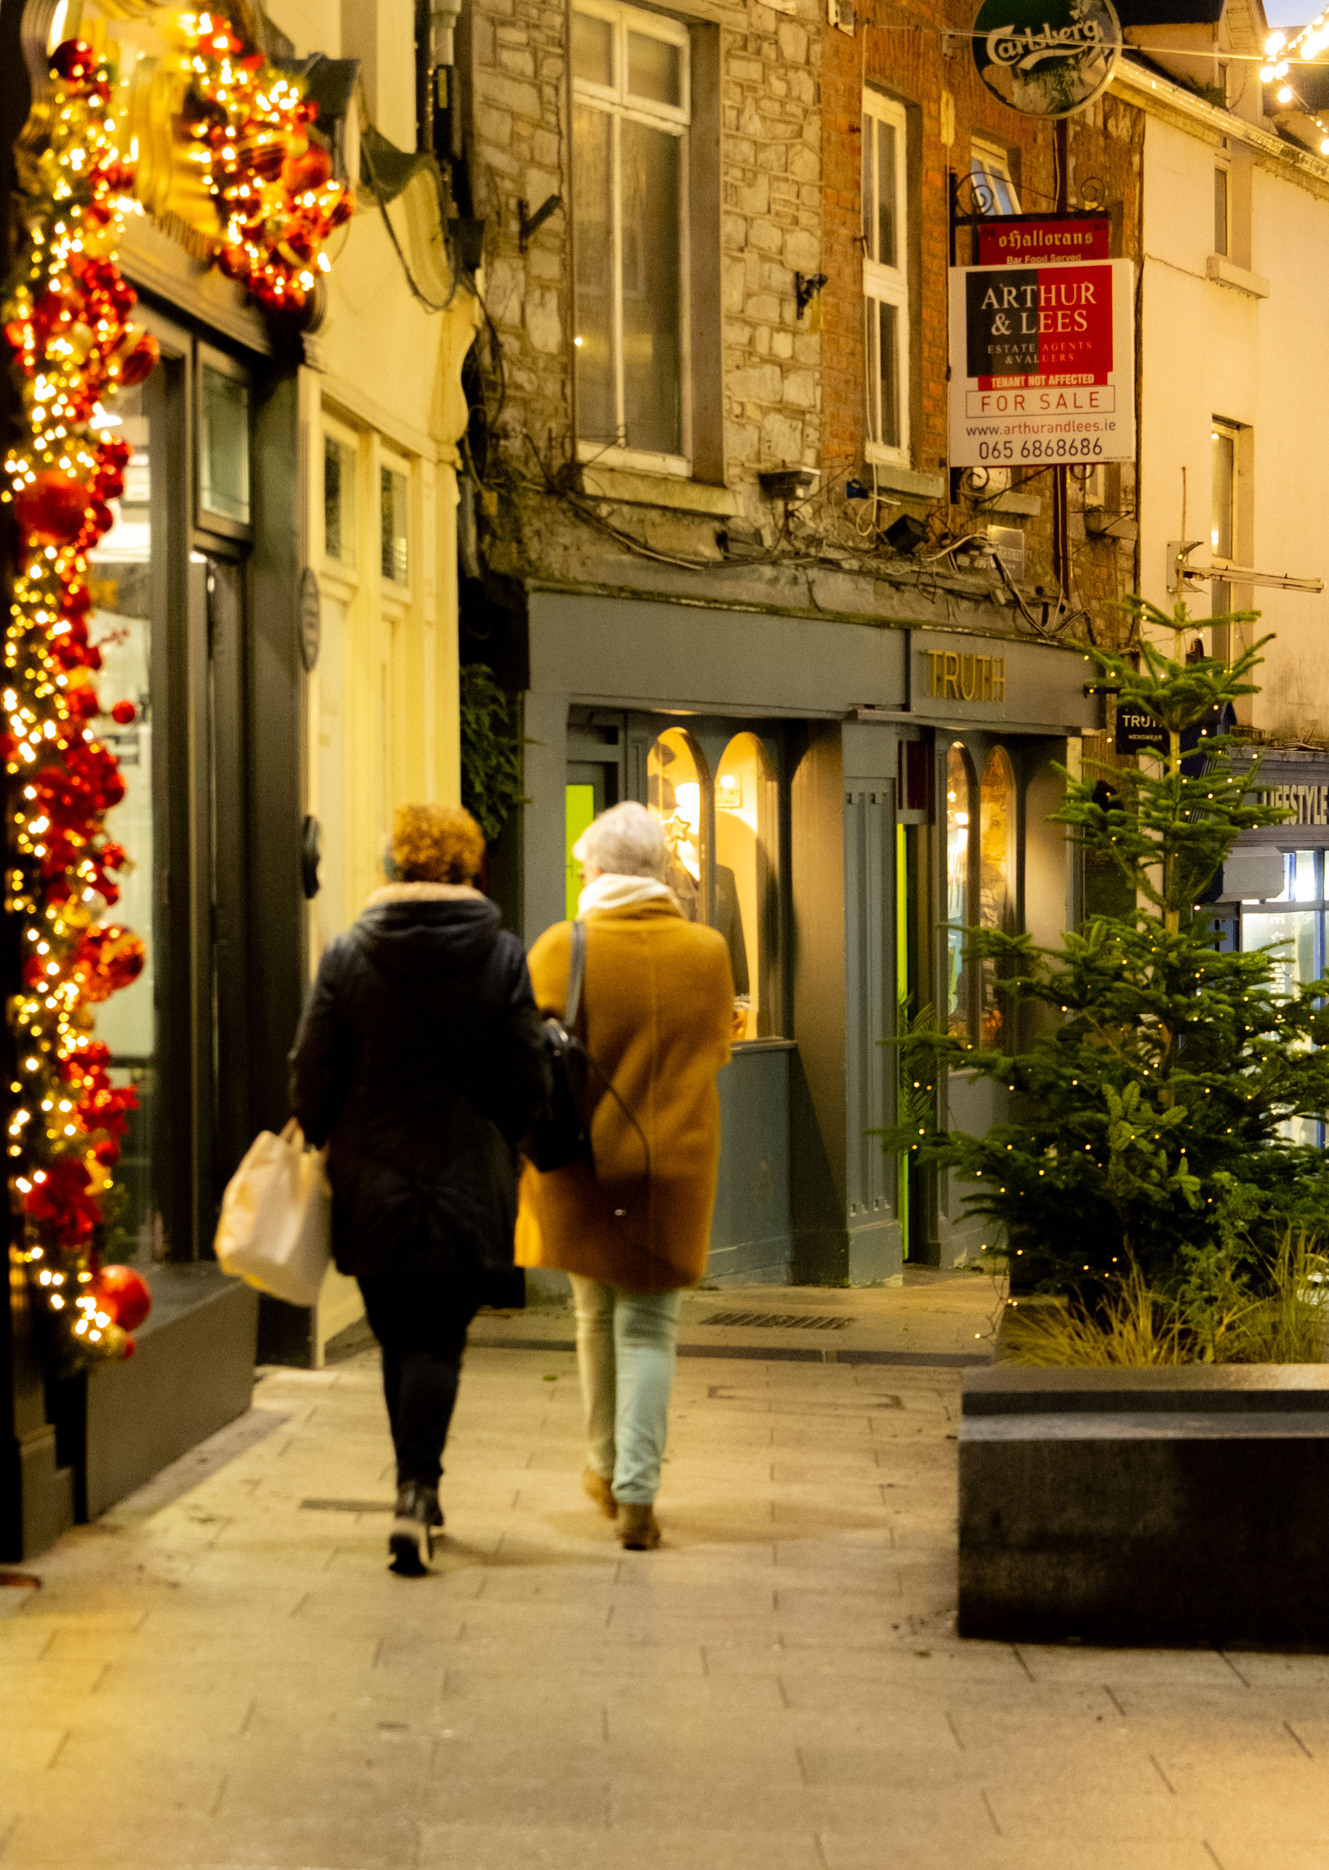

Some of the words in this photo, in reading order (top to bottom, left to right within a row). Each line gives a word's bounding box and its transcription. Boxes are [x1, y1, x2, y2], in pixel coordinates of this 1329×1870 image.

[986, 20, 1102, 67] Carlsberg
[1006, 255, 1022, 265] Bar
[1024, 254, 1048, 264] Food
[1050, 252, 1082, 262] Served
[981, 282, 1097, 310] ARTHUR
[991, 313, 1012, 336] &
[1020, 310, 1088, 335] LEES
[987, 343, 1035, 354] ESTATE
[1042, 341, 1093, 352] AGENTS
[992, 376, 1026, 388] TENANT
[1028, 375, 1046, 387] NOT
[1048, 373, 1095, 386] AFFECTED
[981, 394, 1026, 412] FOR
[1039, 391, 1100, 410] SALE
[965, 418, 1116, 436] www.arthurandlees.ie
[979, 440, 1013, 460] 065
[1020, 437, 1103, 458] 6868686
[928, 649, 1005, 702] TRUTH
[1122, 714, 1162, 728] TRU
